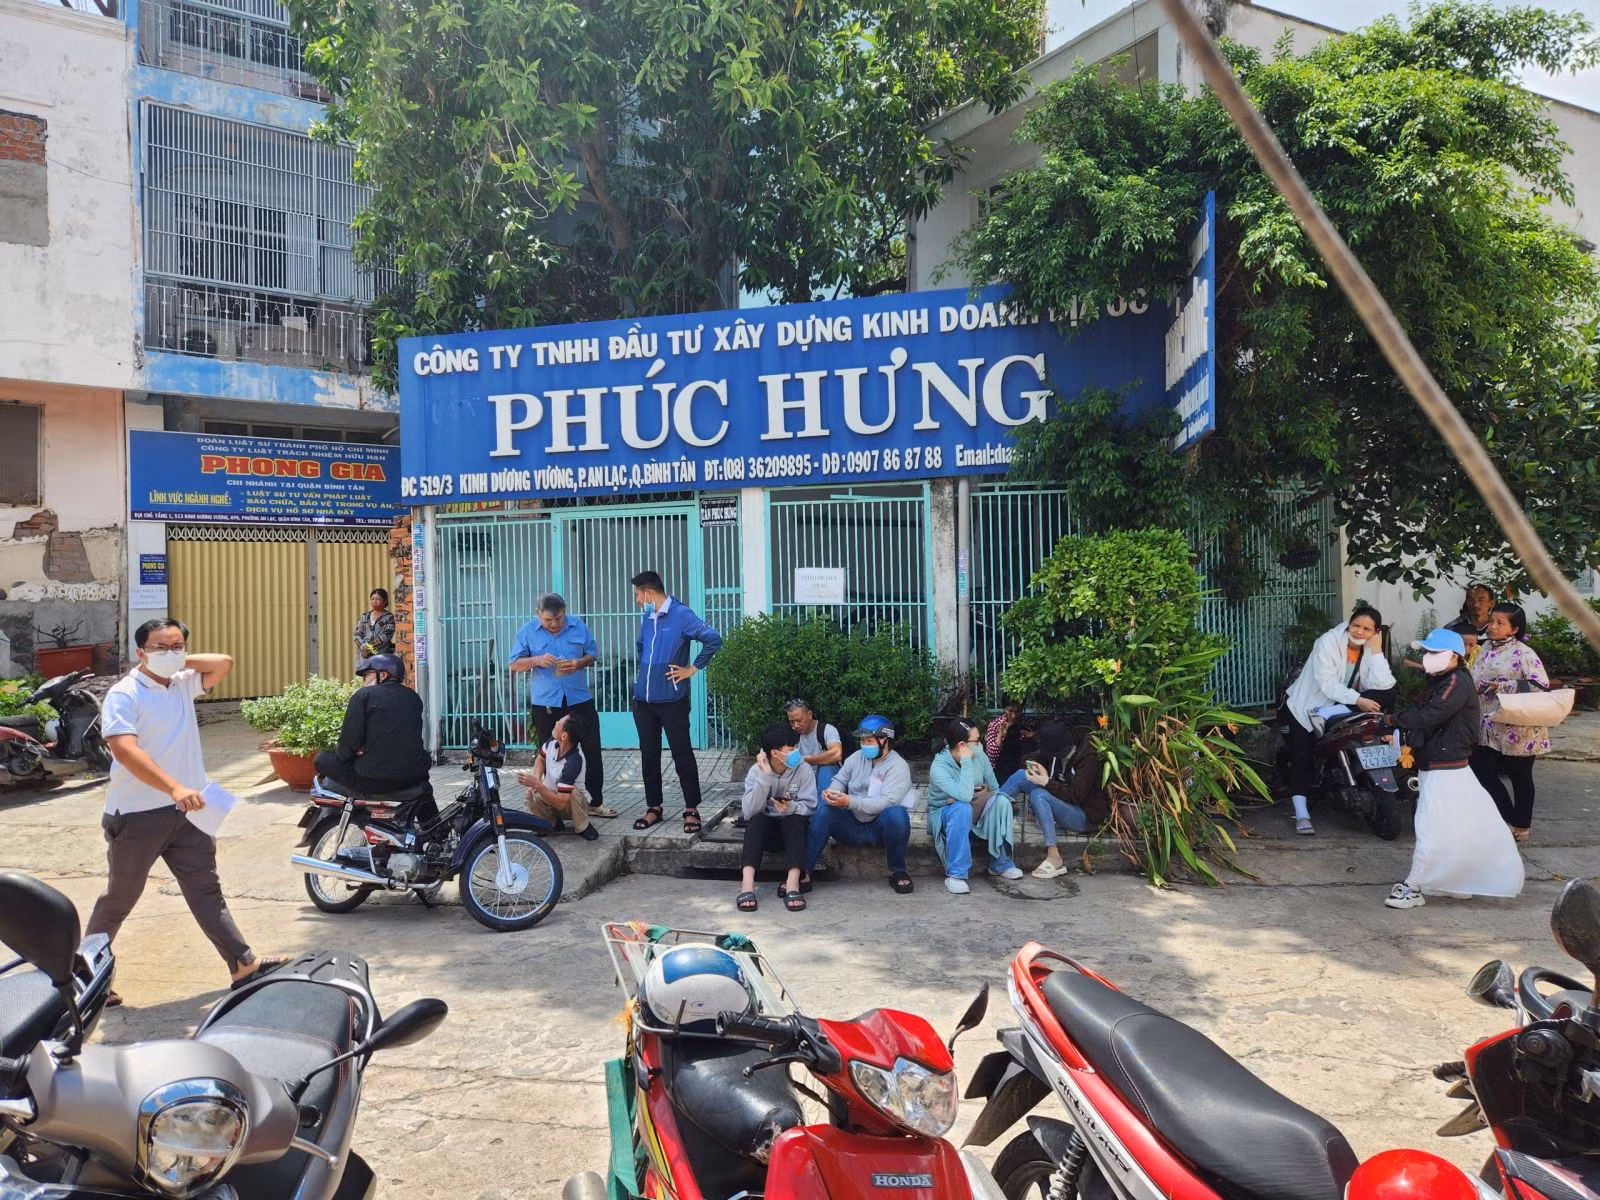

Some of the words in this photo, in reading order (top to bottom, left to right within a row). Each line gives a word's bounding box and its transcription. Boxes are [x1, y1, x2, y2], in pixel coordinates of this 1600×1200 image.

[413, 344, 479, 376] CÔNG
[488, 344, 523, 369] TY
[531, 338, 600, 367] TNHH
[608, 322, 658, 360] ĐẦU
[667, 323, 704, 356] TƯ
[713, 317, 765, 351] XÂY
[777, 314, 852, 351] DỰNG
[862, 307, 929, 339] KINH
[488, 358, 730, 457] PHÚC
[758, 347, 1054, 441] HƯNG
[201, 444, 229, 452] CÔNG
[201, 454, 321, 478] PHONG
[330, 462, 386, 482] GIA
[401, 475, 417, 498] ĐC
[420, 474, 453, 496] 519/3
[459, 471, 488, 495] KINH
[490, 467, 531, 493] DƯƠNG
[672, 455, 696, 483] TÂN
[748, 453, 812, 479] 36209895
[883, 449, 901, 471] 86
[904, 446, 922, 470] 87
[924, 446, 942, 469] 88
[874, 1176, 933, 1186] HONDA
